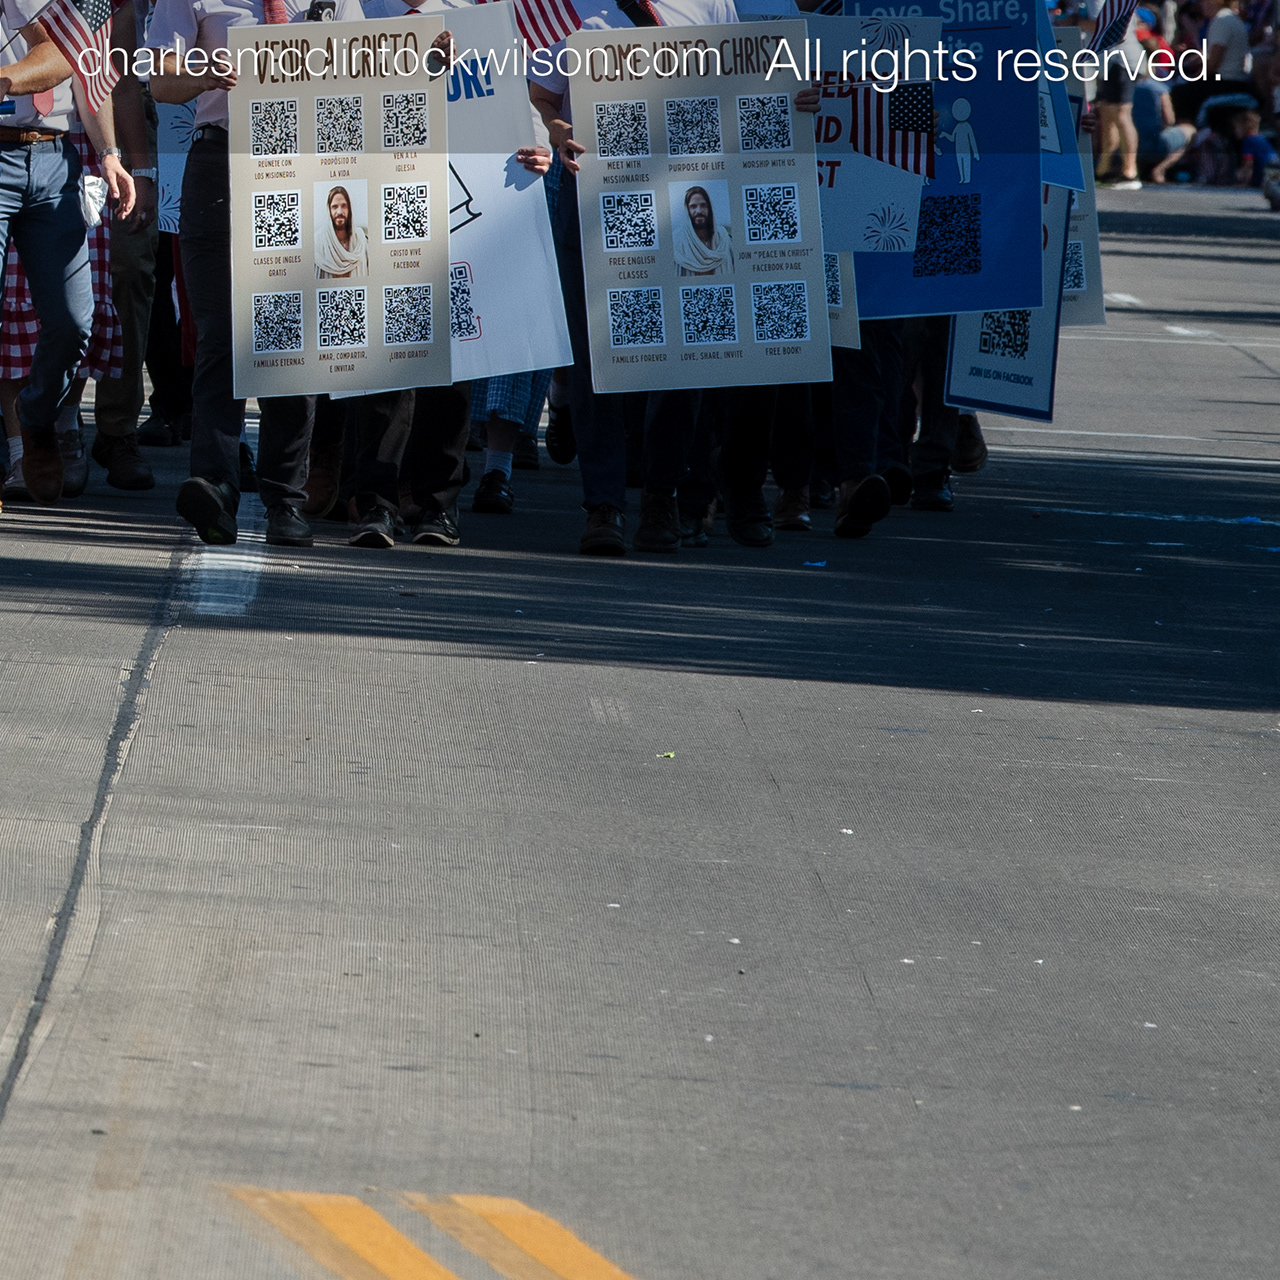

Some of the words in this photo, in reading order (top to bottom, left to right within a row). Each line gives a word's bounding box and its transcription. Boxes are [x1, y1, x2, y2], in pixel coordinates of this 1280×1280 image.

[255, 38, 312, 84] VENIR
[322, 37, 338, 80] A
[348, 32, 419, 79] CRISTO
[591, 42, 643, 83] COME
[653, 39, 710, 79] UNTO
[720, 35, 784, 76] CHRIST
[350, 156, 357, 164] DE
[393, 152, 405, 160] VEN
[281, 158, 292, 167] CON
[607, 161, 624, 170] MEET
[625, 160, 642, 169] WITH
[668, 162, 699, 172] PURPOSE
[701, 162, 709, 170] OF
[711, 161, 725, 170] LIFE
[742, 160, 770, 169] WORSHIP
[771, 159, 787, 168] WITH
[788, 158, 796, 167] US
[395, 164, 416, 172] IGLESIA
[254, 172, 264, 180] LOS
[265, 170, 296, 180] MISIONEROS
[330, 170, 338, 178] LA
[339, 169, 350, 178] VIDA
[603, 173, 650, 184] MISSIONARIES
[389, 249, 409, 257] CRISTO
[410, 248, 422, 256] VIVE
[738, 251, 752, 260] JOIN
[753, 250, 777, 259] "PEACE
[778, 249, 786, 257] IN
[253, 257, 274, 266] CLASES
[393, 261, 421, 269] FACEBOOK
[609, 257, 626, 266] FREE
[627, 255, 656, 265] ENGLISH
[752, 263, 784, 272] FACEBOOK
[785, 261, 802, 271] PAGE
[268, 269, 287, 277] GRATIS
[618, 270, 649, 280] CLASSES
[407, 350, 429, 360] GRATIS!
[680, 352, 698, 362] LOVE,
[700, 351, 722, 360] SHARE,
[723, 349, 744, 359] INVITE
[765, 347, 781, 356] FREE
[782, 346, 802, 356] BOOK!
[253, 359, 280, 368] FAMILIAS
[280, 357, 305, 367] ETERNAS
[612, 355, 640, 364] FAMILIES
[640, 353, 668, 363] FOREVER
[334, 364, 355, 372] INVITAR
